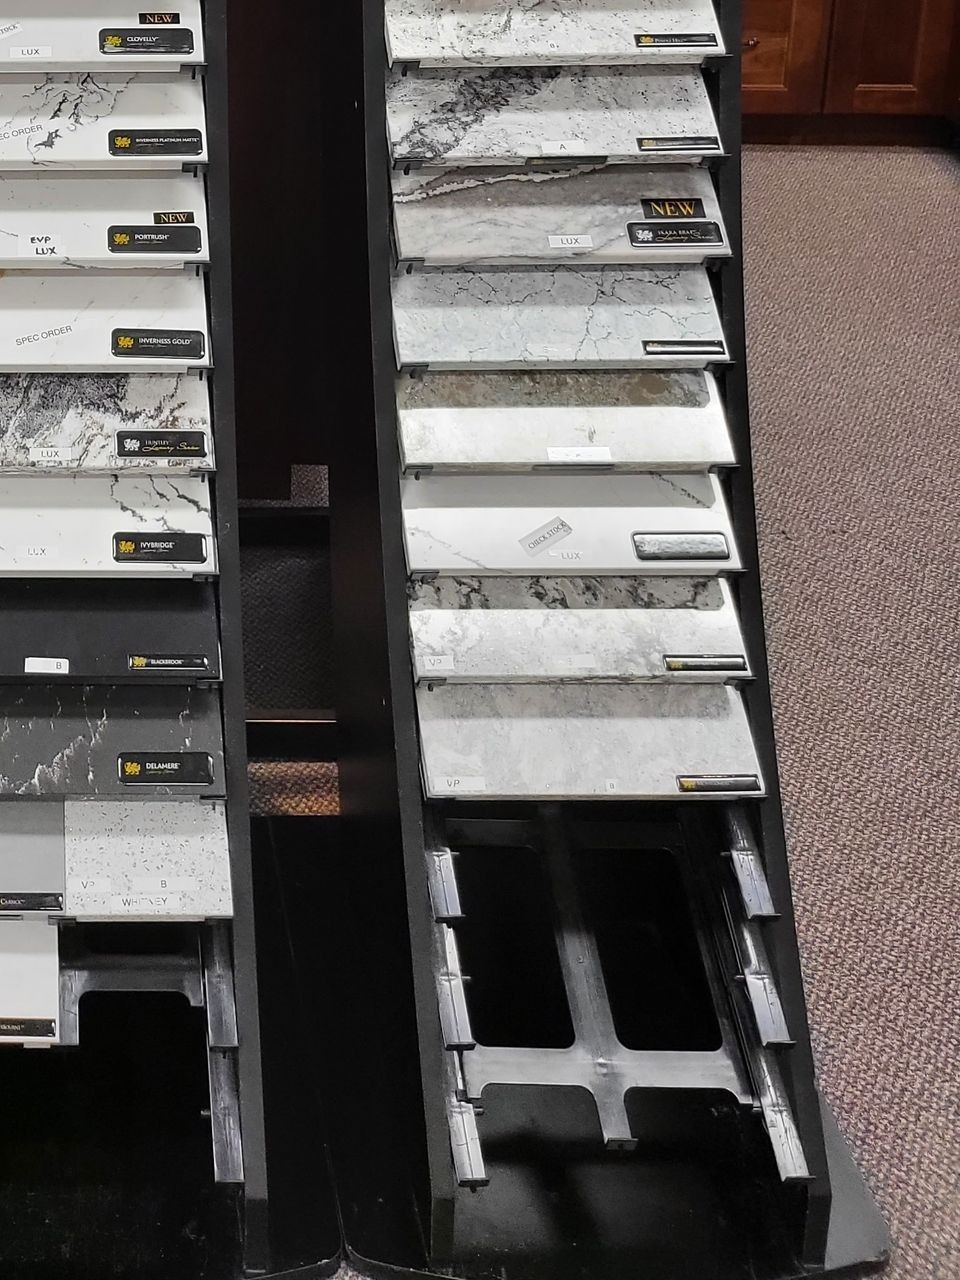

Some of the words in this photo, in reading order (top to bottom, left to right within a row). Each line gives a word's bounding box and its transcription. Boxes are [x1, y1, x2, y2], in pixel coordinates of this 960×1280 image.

[145, 14, 174, 24] NEW
[21, 48, 40, 56] LUX
[12, 124, 43, 138] ORDER
[651, 201, 697, 216] NEW
[160, 213, 188, 223] NEW
[30, 236, 51, 244] EVP
[560, 237, 580, 245] LUX
[35, 246, 57, 255] LUX
[16, 334, 40, 347] SPEC
[41, 325, 73, 339] ORDER
[41, 450, 60, 458] LUX
[140, 541, 174, 549] IVYBRIDGE
[527, 532, 548, 550] CHECK
[27, 547, 47, 556] LUX
[56, 661, 62, 670] B
[446, 779, 460, 787] VP
[160, 880, 167, 889] B
